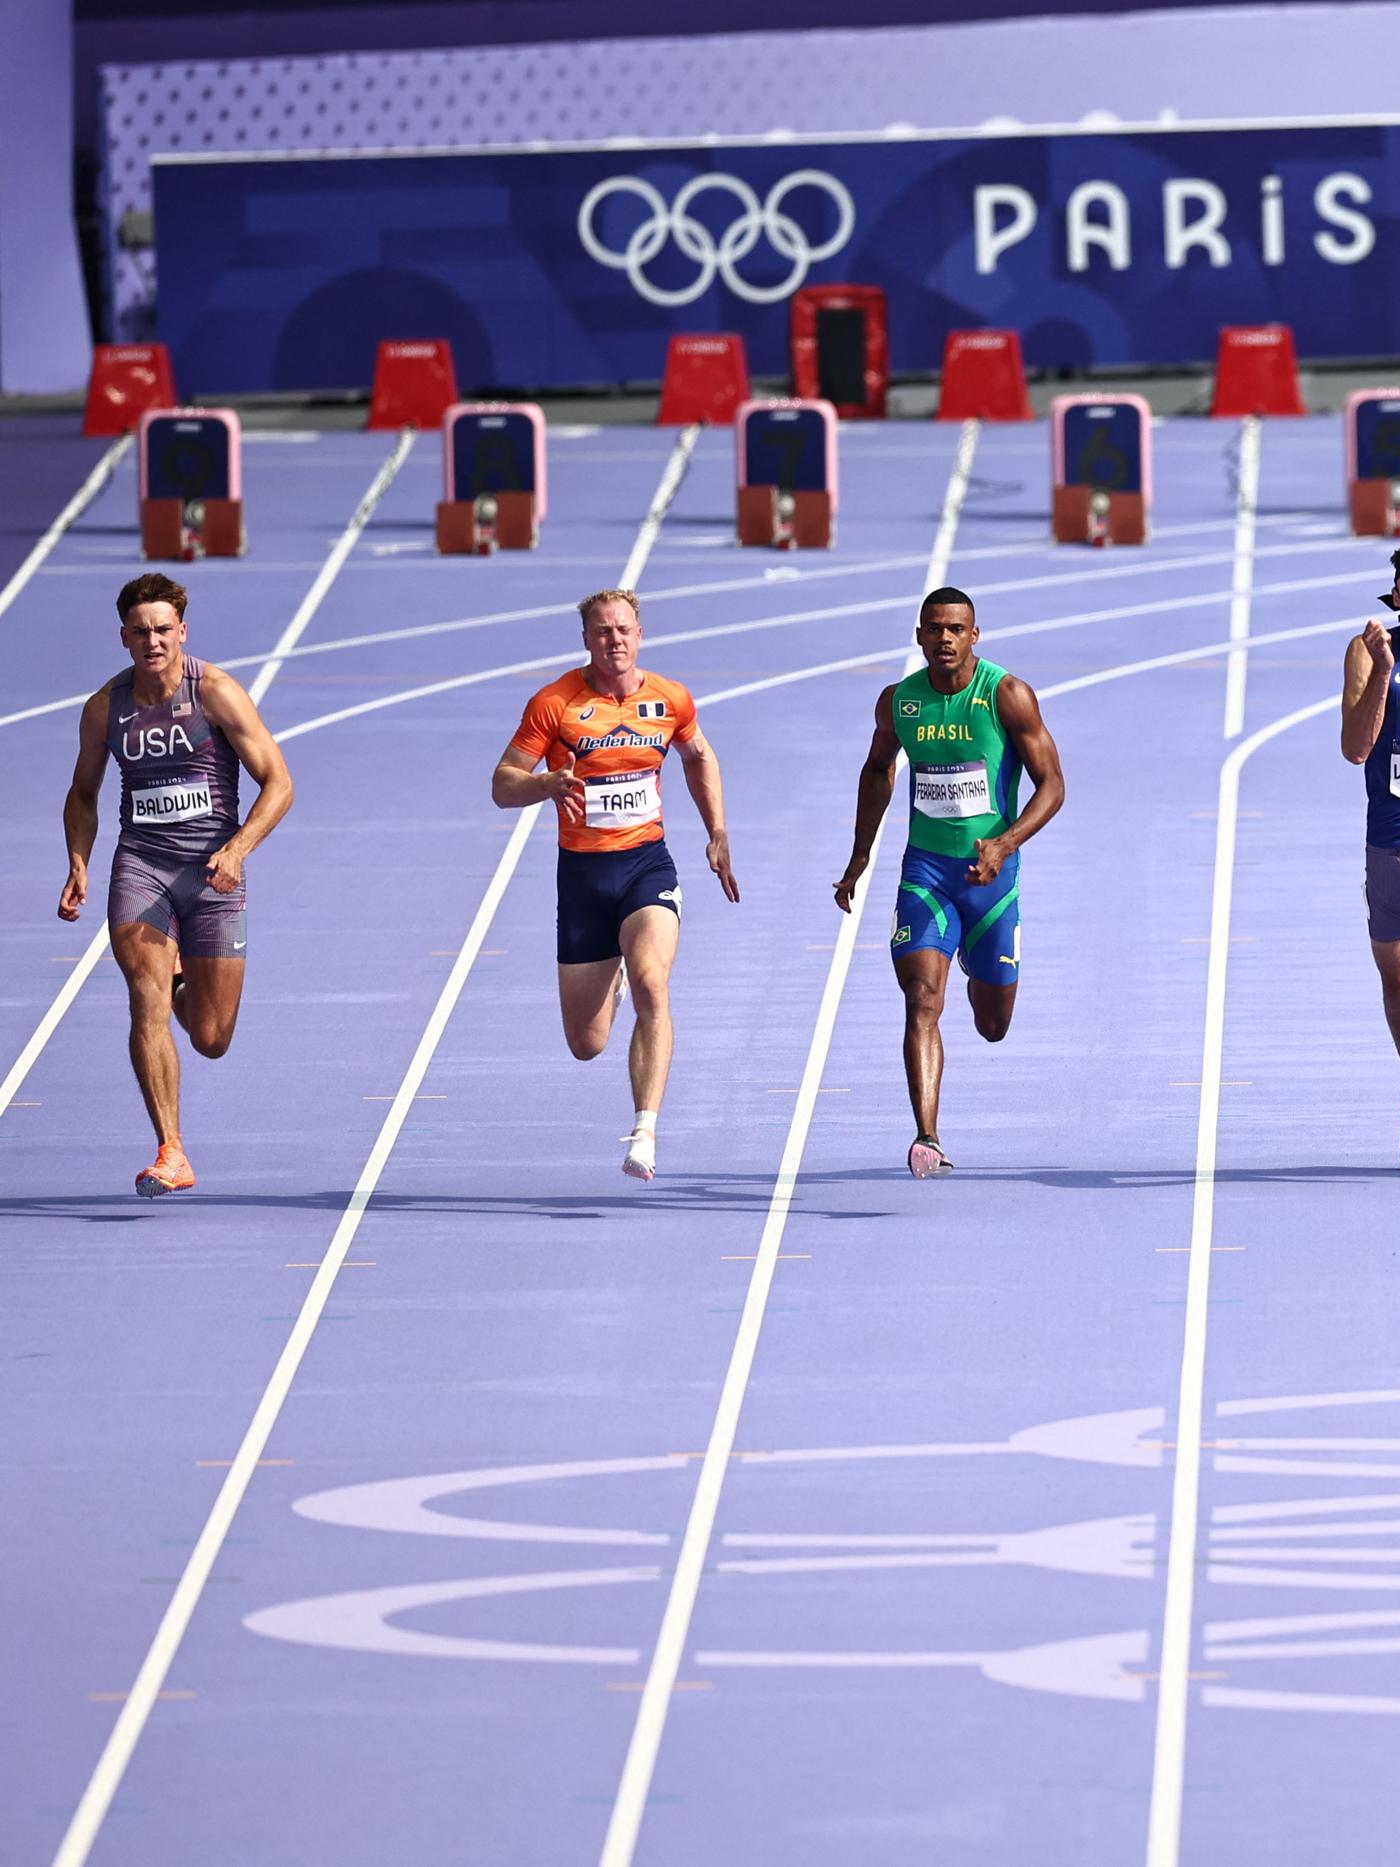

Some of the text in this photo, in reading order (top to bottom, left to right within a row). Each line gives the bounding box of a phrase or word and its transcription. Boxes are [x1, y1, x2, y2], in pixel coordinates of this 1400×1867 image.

[122, 724, 194, 761] USA
[917, 724, 973, 742] BRASIL
[600, 789, 647, 811] TAAM
[948, 780, 987, 801] SANTANA
[136, 790, 209, 817] BALDWIN
